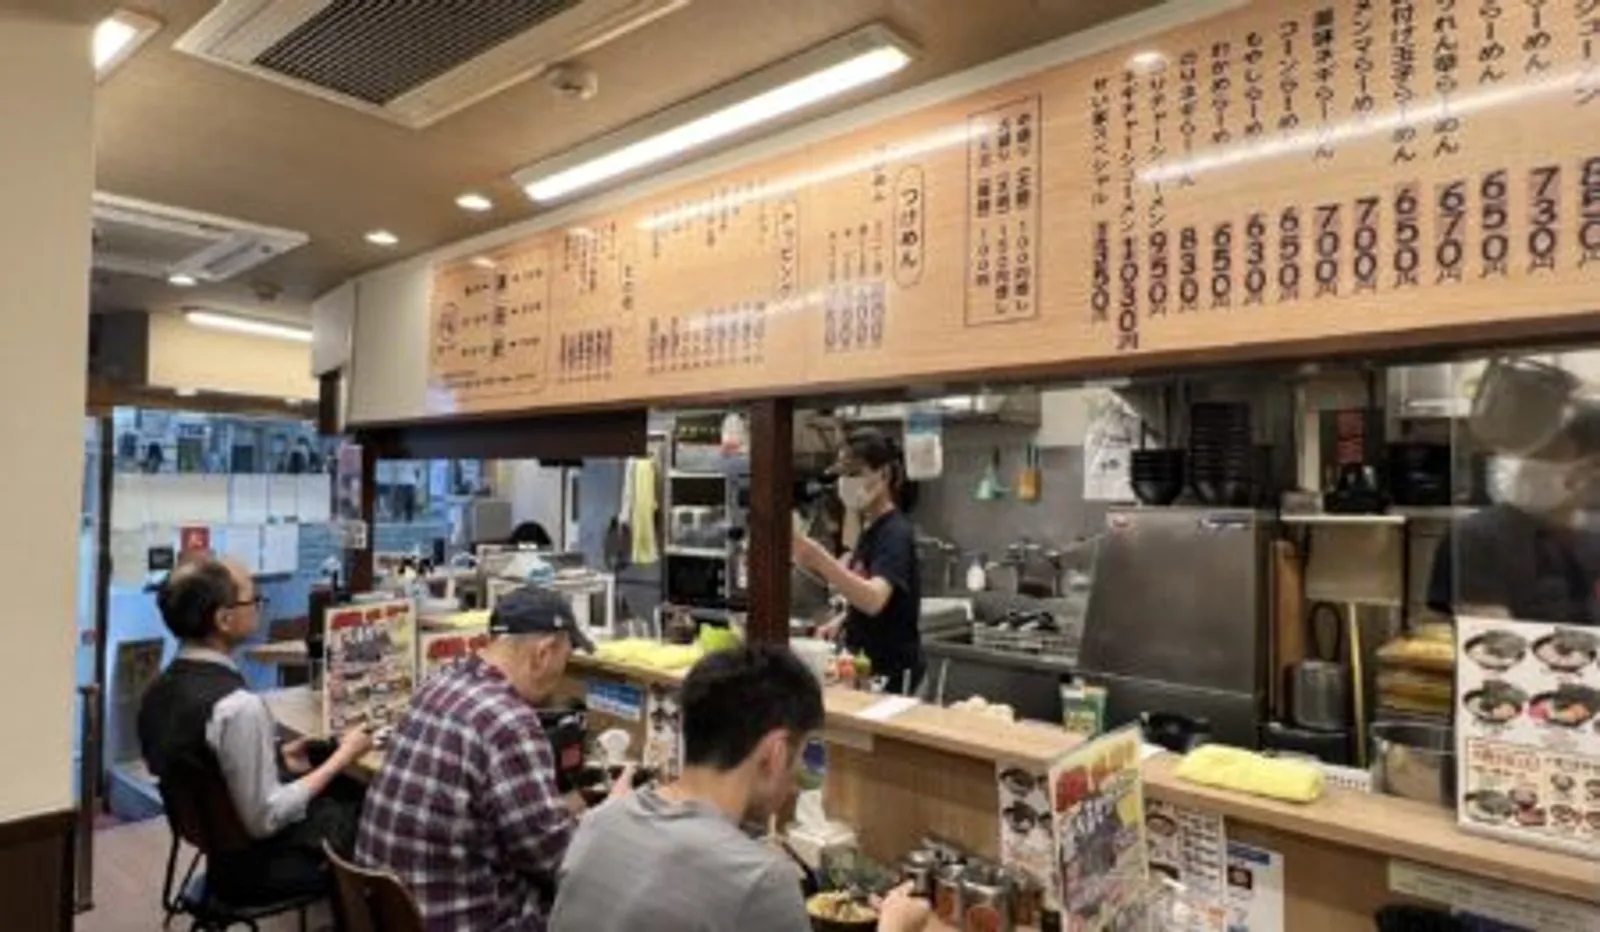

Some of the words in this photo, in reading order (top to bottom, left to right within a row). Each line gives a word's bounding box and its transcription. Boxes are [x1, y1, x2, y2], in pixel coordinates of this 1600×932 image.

[1211, 42, 1231, 145] わかめらーめ
[1244, 32, 1264, 137] もやしらーめ
[1279, 20, 1299, 130] コーンらーめ
[901, 187, 919, 269] つけめん
[1314, 204, 1340, 298] 700円
[1352, 196, 1381, 295] 700円
[1393, 187, 1420, 290] 650円
[1435, 181, 1466, 285] 670円
[1478, 168, 1509, 279] 650円
[1526, 164, 1562, 274] 730円
